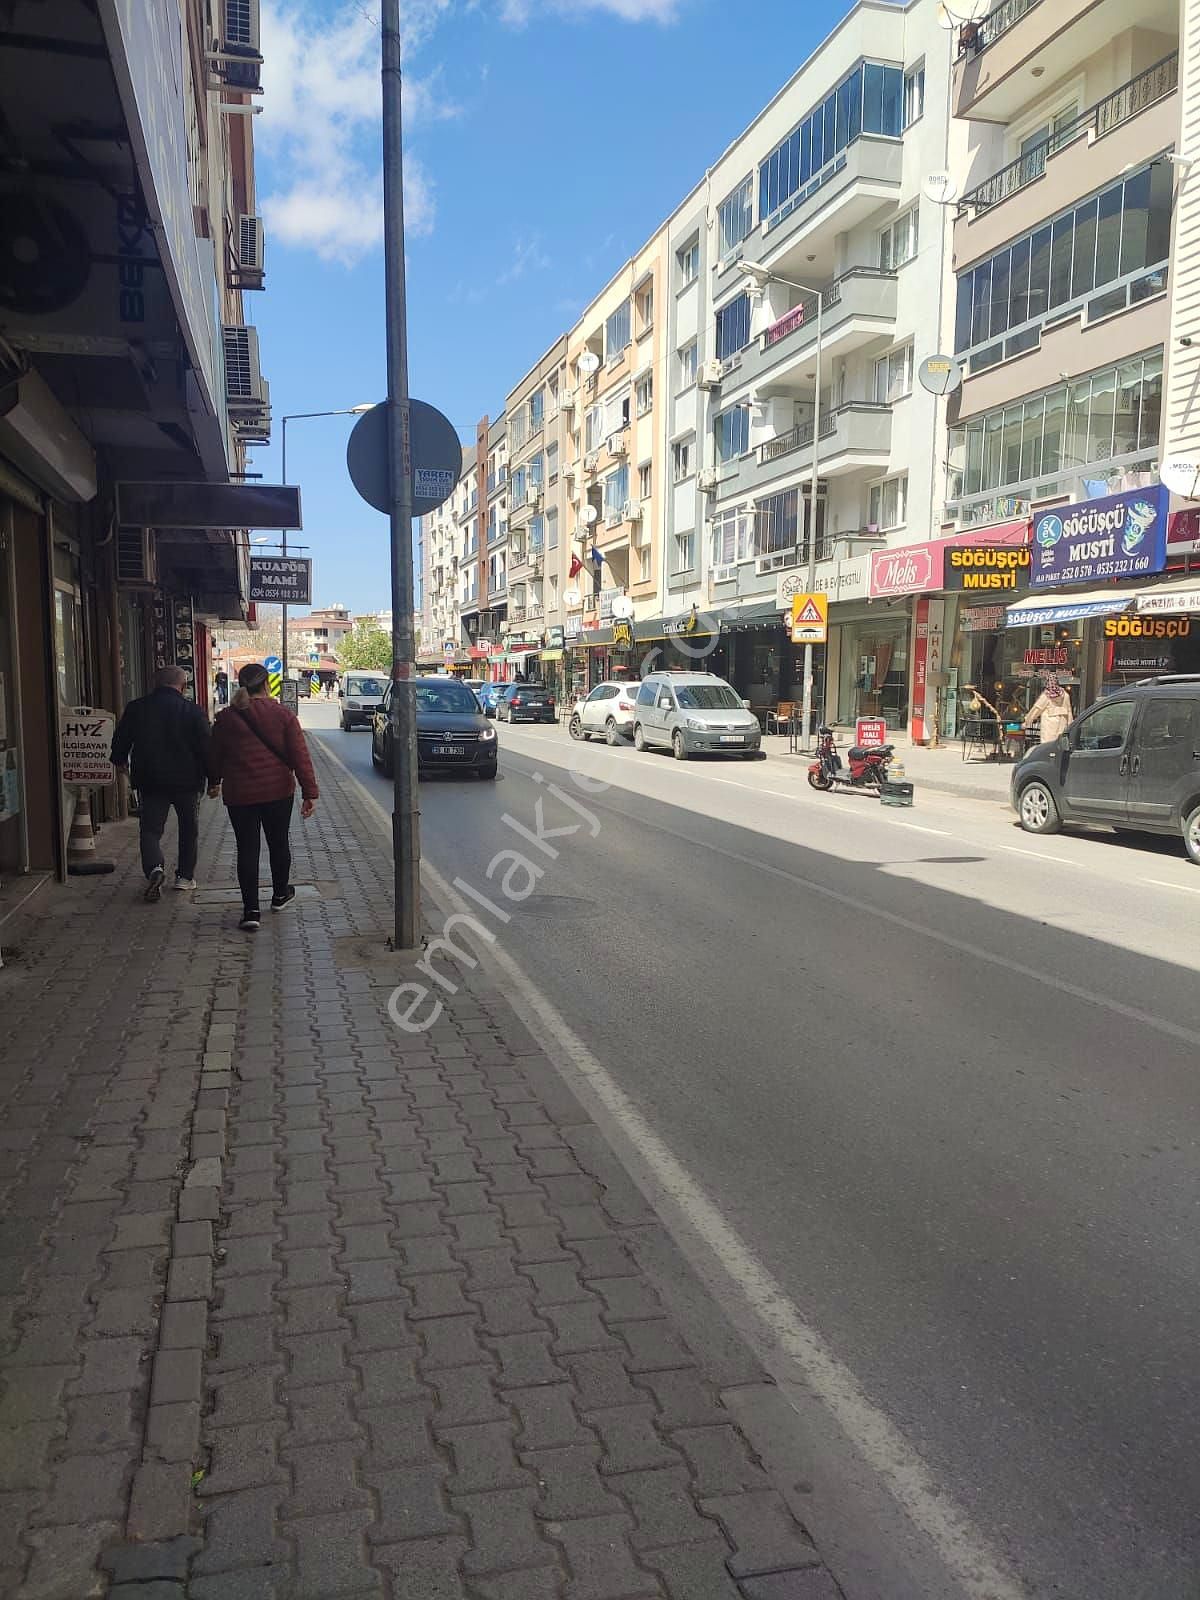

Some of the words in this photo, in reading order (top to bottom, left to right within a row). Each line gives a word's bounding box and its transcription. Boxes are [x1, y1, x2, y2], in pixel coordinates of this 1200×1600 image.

[1063, 503, 1125, 538] SÖĞÜŞÇÜ
[951, 548, 1030, 569] SÖĞÜŞÇÜ
[1070, 534, 1115, 563] MUSTİ
[252, 561, 307, 572] KUAFÖR
[883, 558, 918, 587] Melis
[1135, 556, 1150, 570] 660
[262, 573, 297, 586] MAMİ
[963, 569, 1017, 588] MUSTİ
[1105, 616, 1190, 638] SÖĞÜŞÇÜ
[1024, 647, 1067, 665] MELİS
